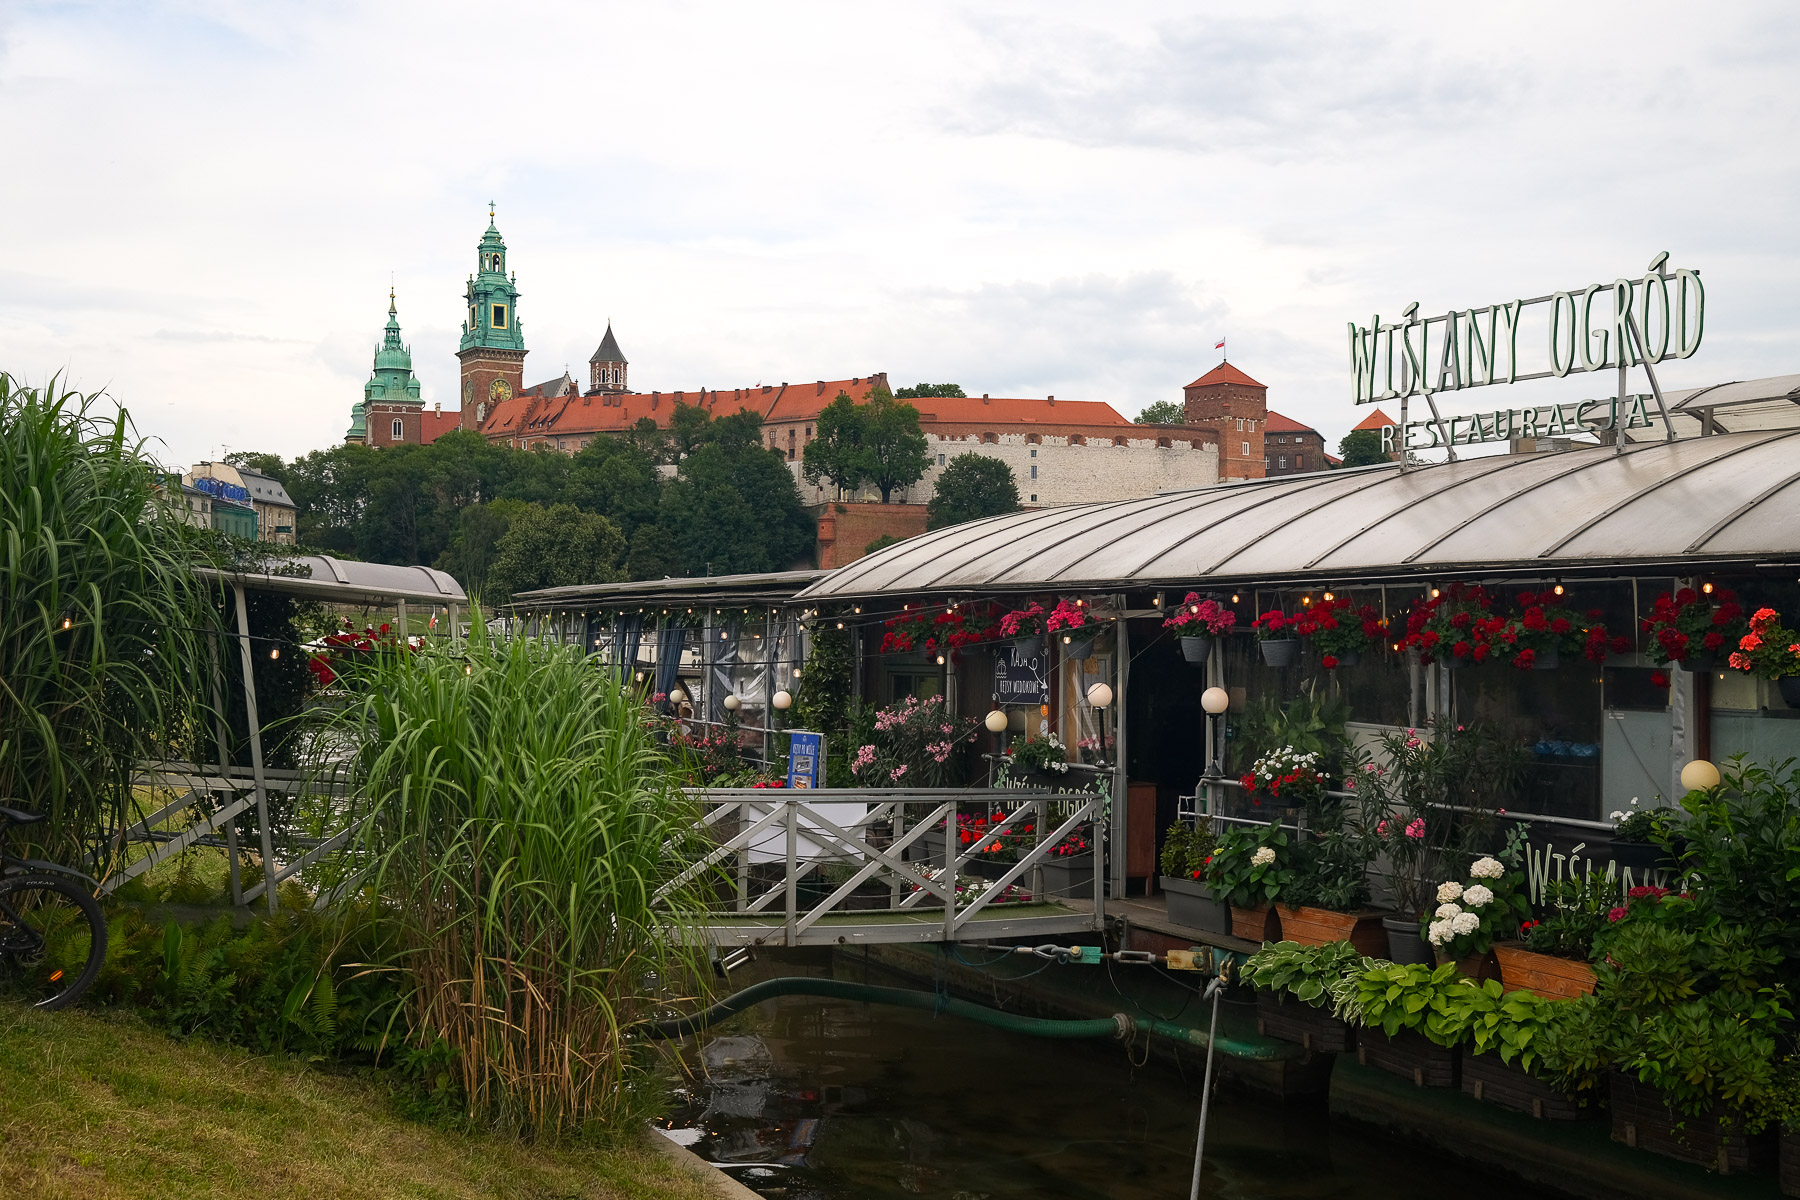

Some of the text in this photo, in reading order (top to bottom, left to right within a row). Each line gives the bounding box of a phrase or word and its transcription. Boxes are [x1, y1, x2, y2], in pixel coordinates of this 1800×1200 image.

[1348, 251, 1705, 405] WIŚLANY OGRÓD
[1381, 394, 1652, 453] RESTAURACJA
[1013, 680, 1039, 694] WIDOKOWE
